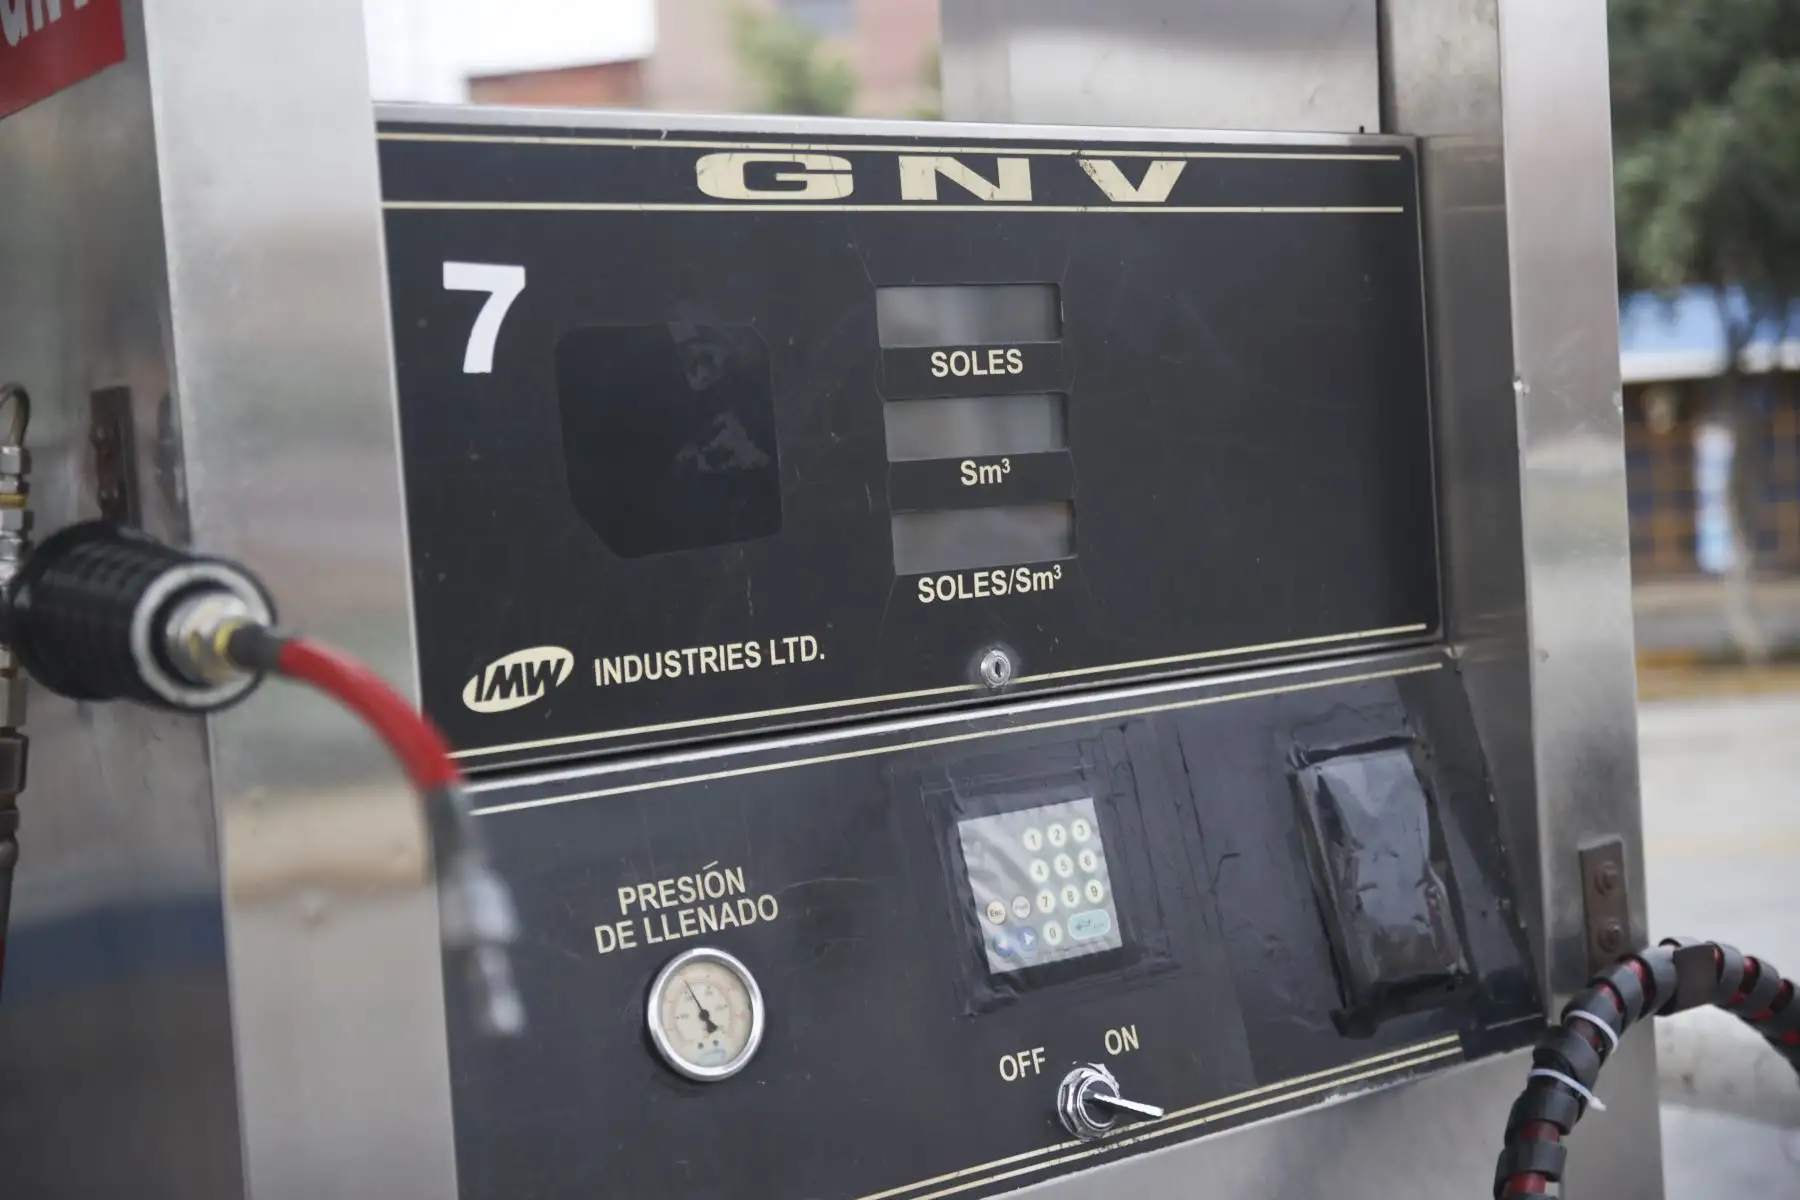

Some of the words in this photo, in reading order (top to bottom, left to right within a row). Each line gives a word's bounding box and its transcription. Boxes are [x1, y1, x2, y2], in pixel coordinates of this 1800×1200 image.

[696, 152, 1187, 203] GNV
[443, 261, 526, 373] 7
[931, 348, 1024, 377] SOLES
[594, 640, 762, 687] INDUSTRIES
[769, 635, 825, 667] LTD.
[617, 860, 746, 916] PRESIÓN
[594, 920, 637, 954] DE
[643, 894, 779, 944] LLENADO
[999, 1046, 1046, 1082] OFF
[1104, 1024, 1140, 1056] ON
